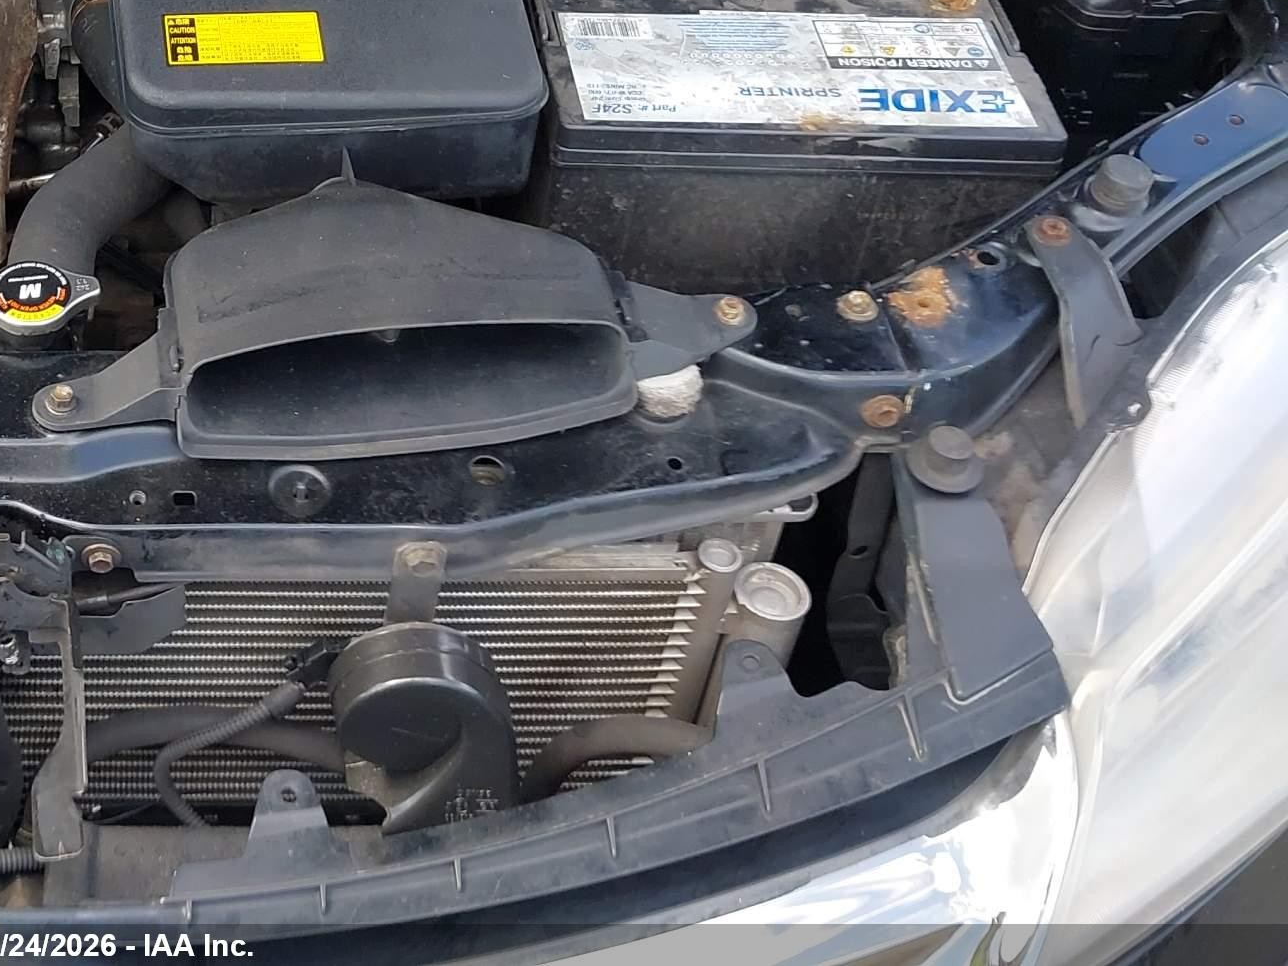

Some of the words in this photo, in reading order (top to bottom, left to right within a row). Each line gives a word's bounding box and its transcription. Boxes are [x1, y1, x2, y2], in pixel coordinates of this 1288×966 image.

[169, 26, 196, 34] CAUTION
[908, 57, 975, 69] DANGER
[738, 86, 843, 99] SPRINTER
[858, 88, 1015, 114] EXIDE
[591, 103, 633, 115] S24F
[652, 104, 677, 113] Part
